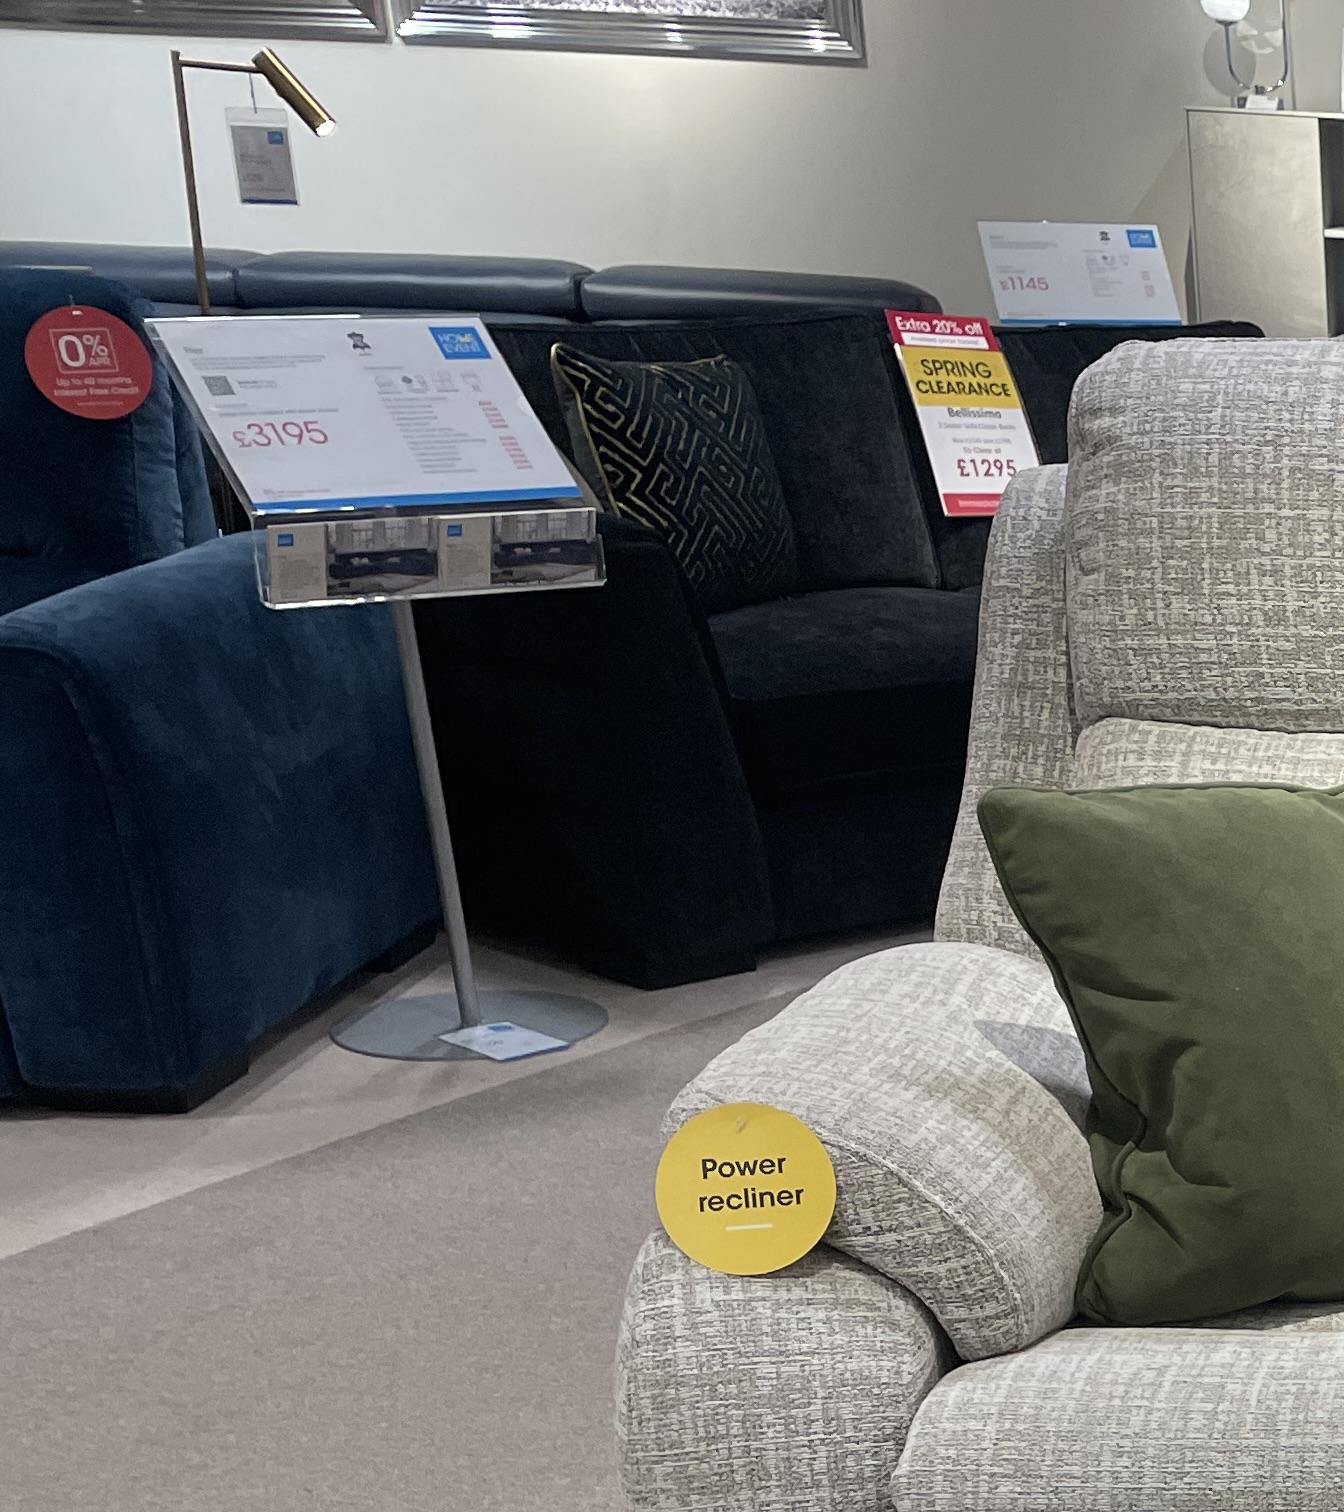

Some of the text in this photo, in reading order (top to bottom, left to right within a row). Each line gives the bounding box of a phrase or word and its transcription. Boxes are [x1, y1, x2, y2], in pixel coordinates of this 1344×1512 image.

[1001, 276, 1049, 291] £1145
[896, 316, 983, 335] Extra 20% off
[58, 334, 108, 367] 0%
[920, 358, 992, 379] SPRING
[915, 379, 1011, 397] CLEARANCE
[947, 407, 1001, 419] Bellissima
[233, 421, 328, 448] £3195
[957, 459, 1017, 477] £1295
[701, 1157, 787, 1180] Power
[699, 1186, 804, 1213] recliner
